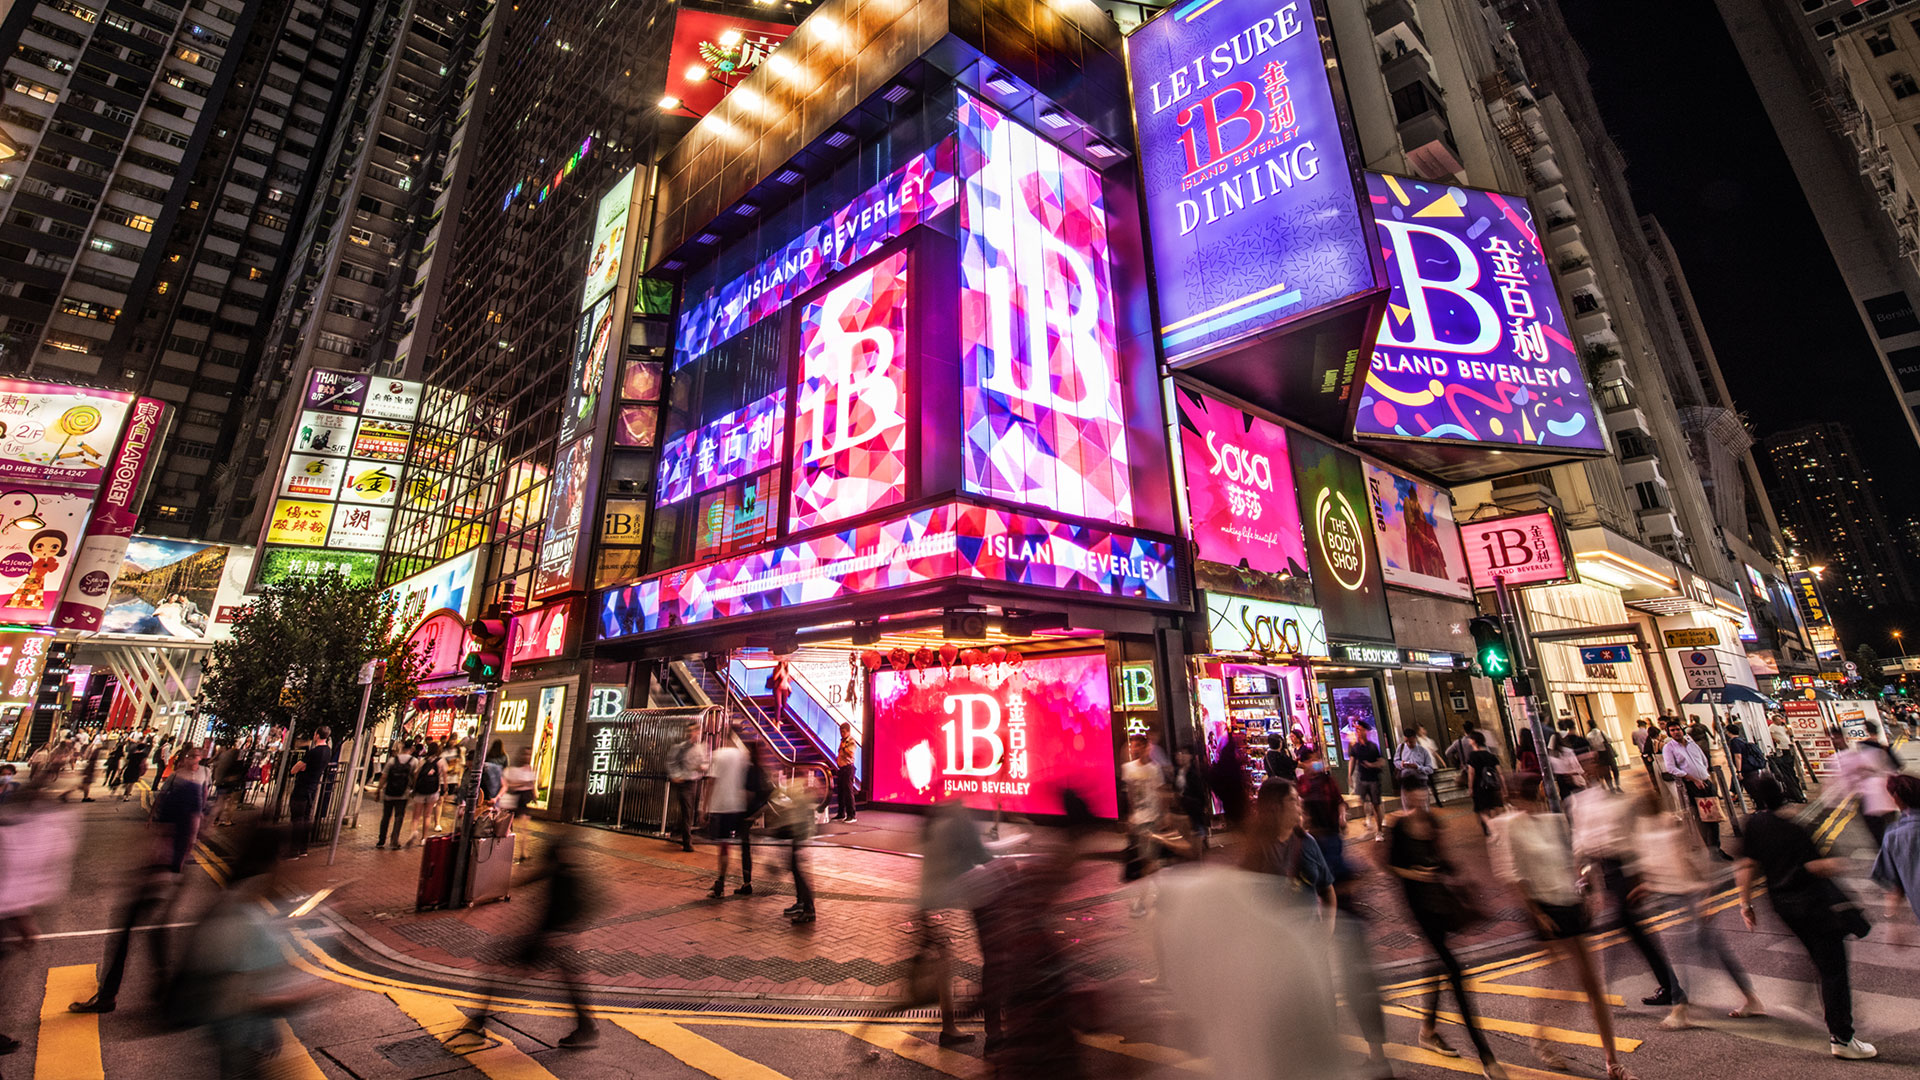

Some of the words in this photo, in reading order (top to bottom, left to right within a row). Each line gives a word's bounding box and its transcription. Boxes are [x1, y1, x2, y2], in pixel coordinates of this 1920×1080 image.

[1150, 2, 1303, 115] LEISURE
[1258, 60, 1296, 134] 金百利
[1176, 81, 1265, 179] iB
[1181, 162, 1228, 192] ISLAND
[1233, 126, 1300, 165] BEVERLEY
[1176, 140, 1320, 237] DINING
[747, 248, 814, 301] ISLAND
[823, 169, 930, 256] BEVERLEY
[982, 195, 1111, 419] iB
[1481, 235, 1551, 362] 金百利
[315, 371, 338, 385] THAI
[1370, 352, 1450, 376] SLAND
[1457, 359, 1559, 387] BEVERLEY
[311, 392, 325, 401] 8/F
[800, 327, 899, 463] iB
[7, 443, 23, 453] 1/F
[16, 425, 43, 439] 2/F
[695, 411, 774, 476] 金百利
[15, 465, 37, 474] HERE
[42, 467, 65, 476] 2864
[65, 470, 87, 478] 4247
[107, 441, 146, 507] LAFORET
[351, 466, 397, 493] 金
[286, 506, 322, 519] 傷心
[343, 508, 371, 531] 潮
[1228, 485, 1263, 521] 莎莎
[1368, 475, 1388, 534] izzue
[273, 519, 326, 533] 酸辣粉
[603, 513, 632, 535] iB
[1221, 525, 1243, 543] making
[1241, 526, 1254, 543] life
[1253, 532, 1278, 548] beautiful
[1329, 516, 1349, 536] THE
[987, 534, 1063, 568] ISLAN
[1327, 535, 1358, 554] BODY
[1481, 528, 1534, 571] iB
[1530, 524, 1550, 563] 金百利
[1333, 551, 1359, 572] SHOP
[1488, 567, 1515, 577] ISLAND
[1517, 562, 1554, 574] BEVERLEY
[1800, 577, 1825, 621] IKEA
[1346, 647, 1363, 661] THE
[1362, 648, 1382, 663] BODY
[1123, 667, 1155, 705] iB
[1689, 669, 1702, 677] 24
[1702, 669, 1718, 677] hrs
[1694, 678, 1718, 686] 全日
[495, 690, 529, 732] izzue
[589, 688, 623, 720] iB
[828, 684, 842, 704] iB
[942, 693, 1005, 776] iB
[1005, 693, 1028, 780] 金百利
[587, 729, 615, 796] 金百利
[944, 780, 978, 793] ISLAND
[981, 781, 1031, 796] BEVERLEY
